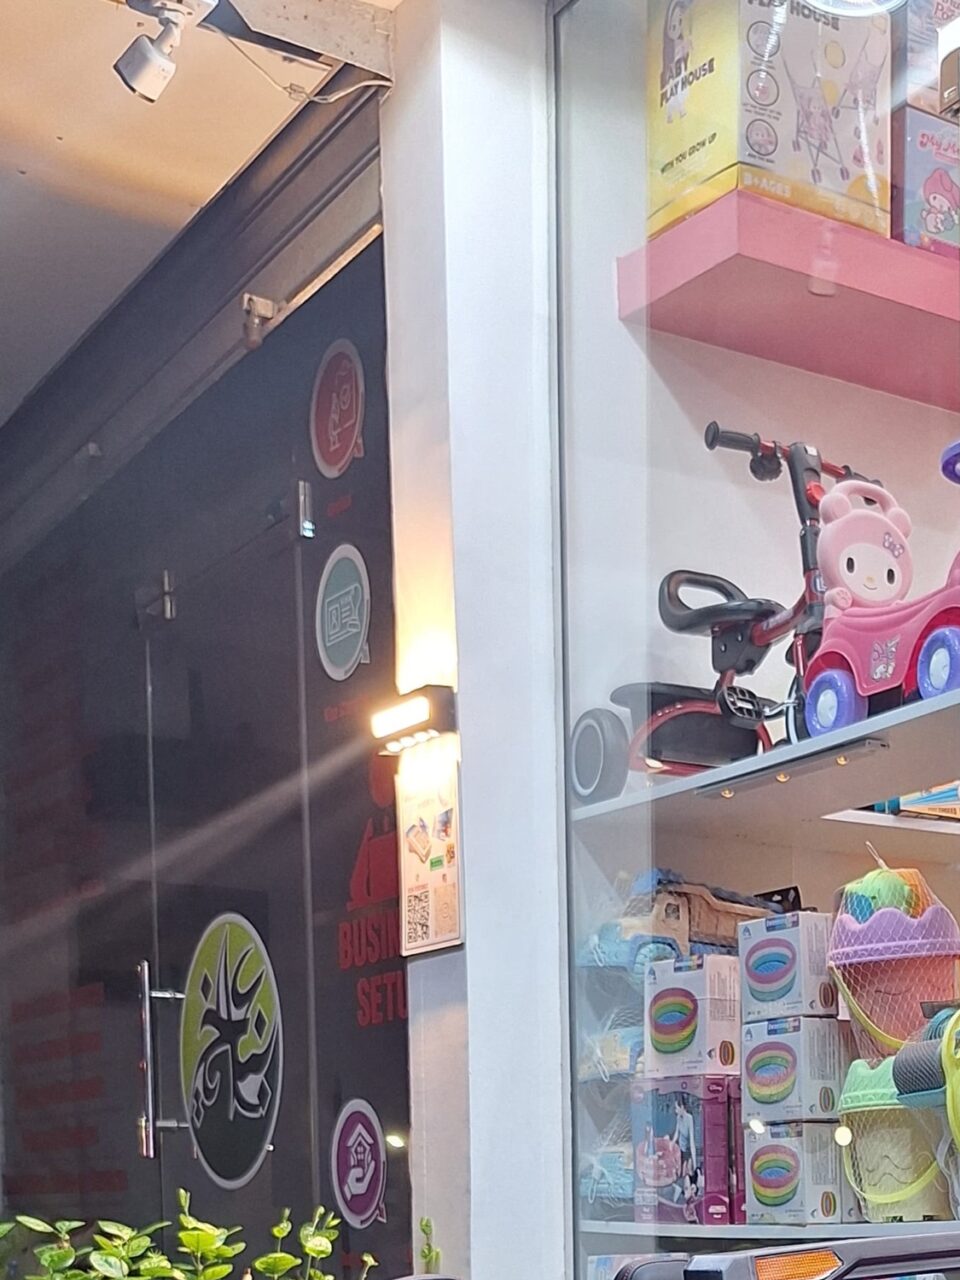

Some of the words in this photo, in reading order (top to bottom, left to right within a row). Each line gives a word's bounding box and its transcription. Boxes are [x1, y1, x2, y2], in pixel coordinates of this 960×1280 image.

[681, 57, 715, 92] HOUSE
[674, 150, 687, 166] YOU
[708, 132, 717, 145] UP
[357, 971, 408, 1027] SETU
